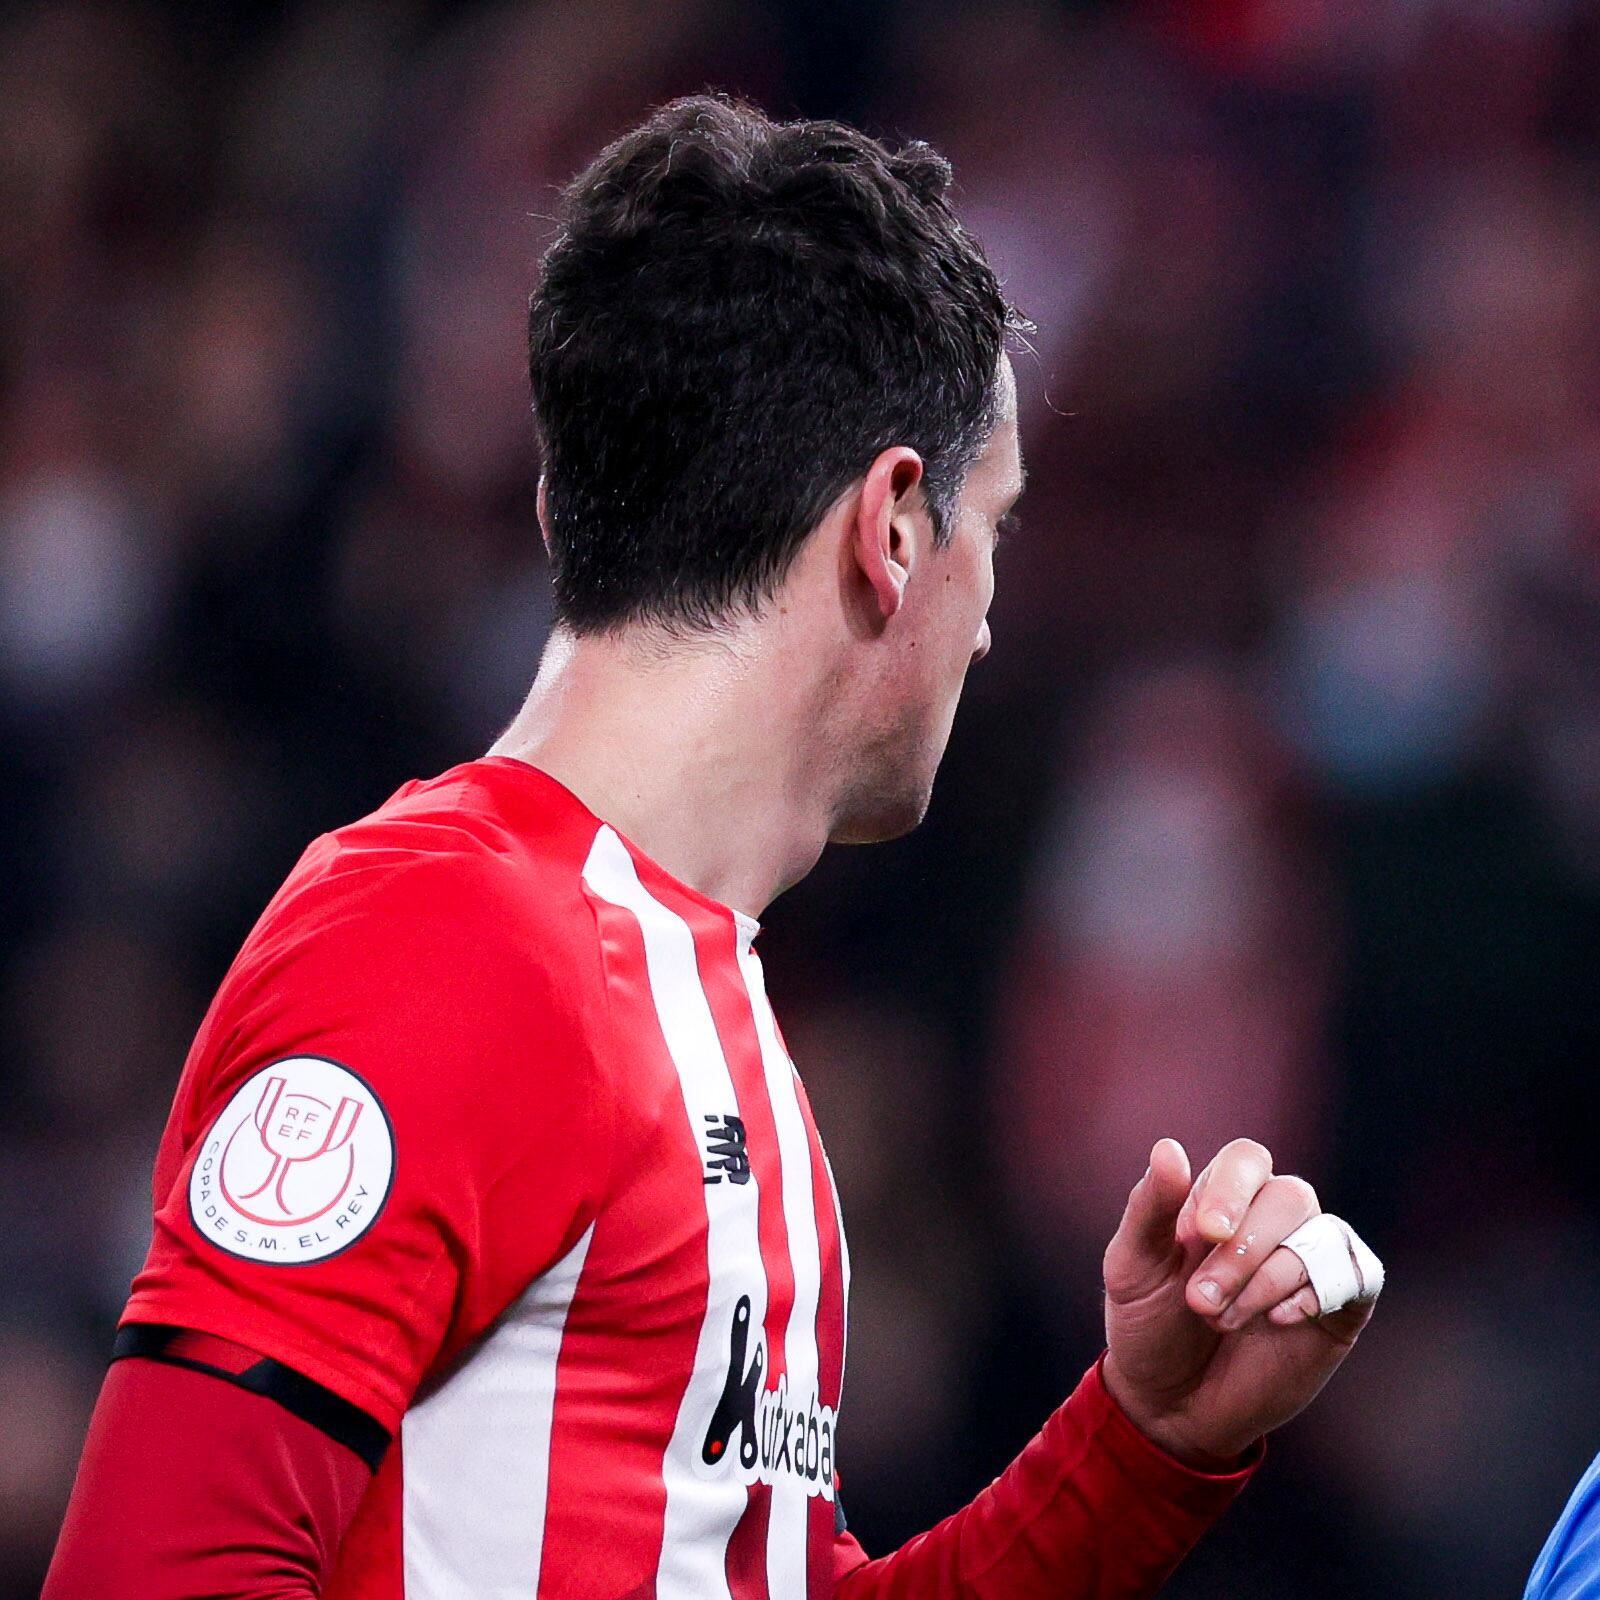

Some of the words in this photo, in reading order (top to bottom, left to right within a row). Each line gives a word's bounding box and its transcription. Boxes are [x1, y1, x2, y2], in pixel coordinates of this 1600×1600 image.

[205, 1205, 228, 1231] DE
[299, 1231, 330, 1248] EL
[336, 1185, 369, 1229] REY
